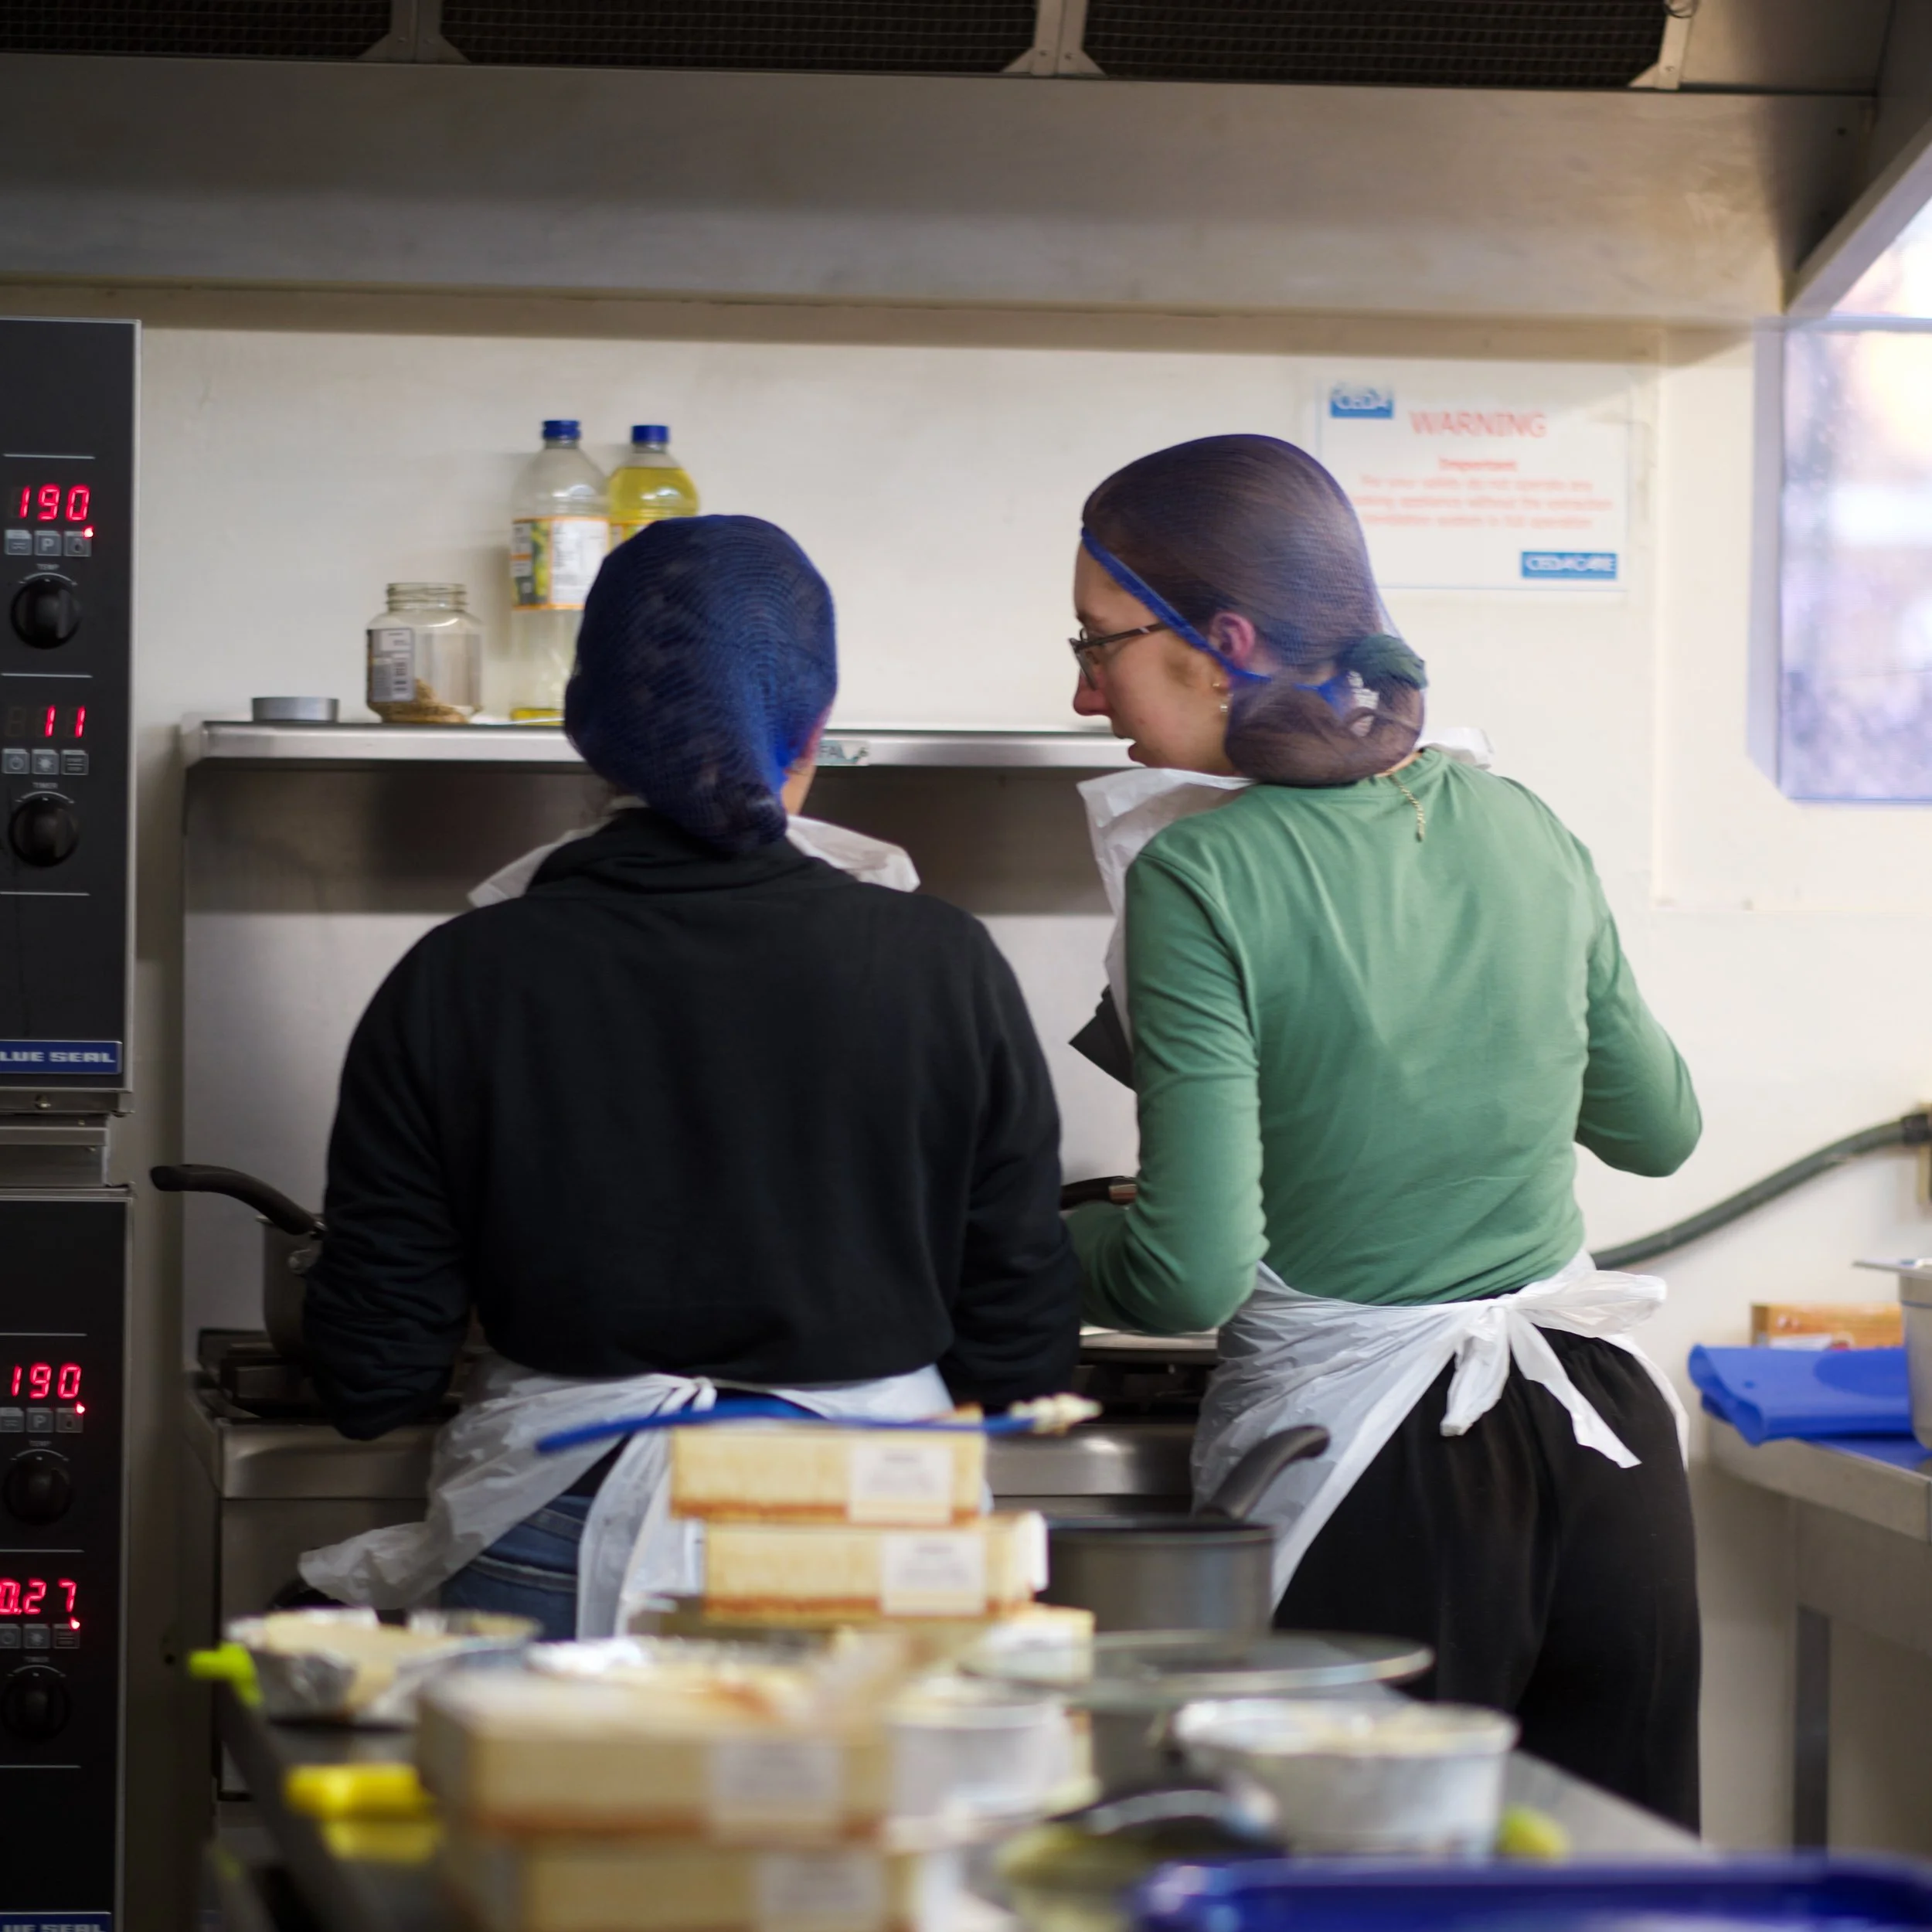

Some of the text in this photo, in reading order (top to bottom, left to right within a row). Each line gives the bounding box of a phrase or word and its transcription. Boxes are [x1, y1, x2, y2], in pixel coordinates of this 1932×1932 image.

[1408, 410, 1548, 438] WARNING
[19, 484, 90, 522] 190
[44, 705, 86, 738] 11
[49, 1052, 116, 1063] SEAL
[11, 1362, 82, 1400] 190
